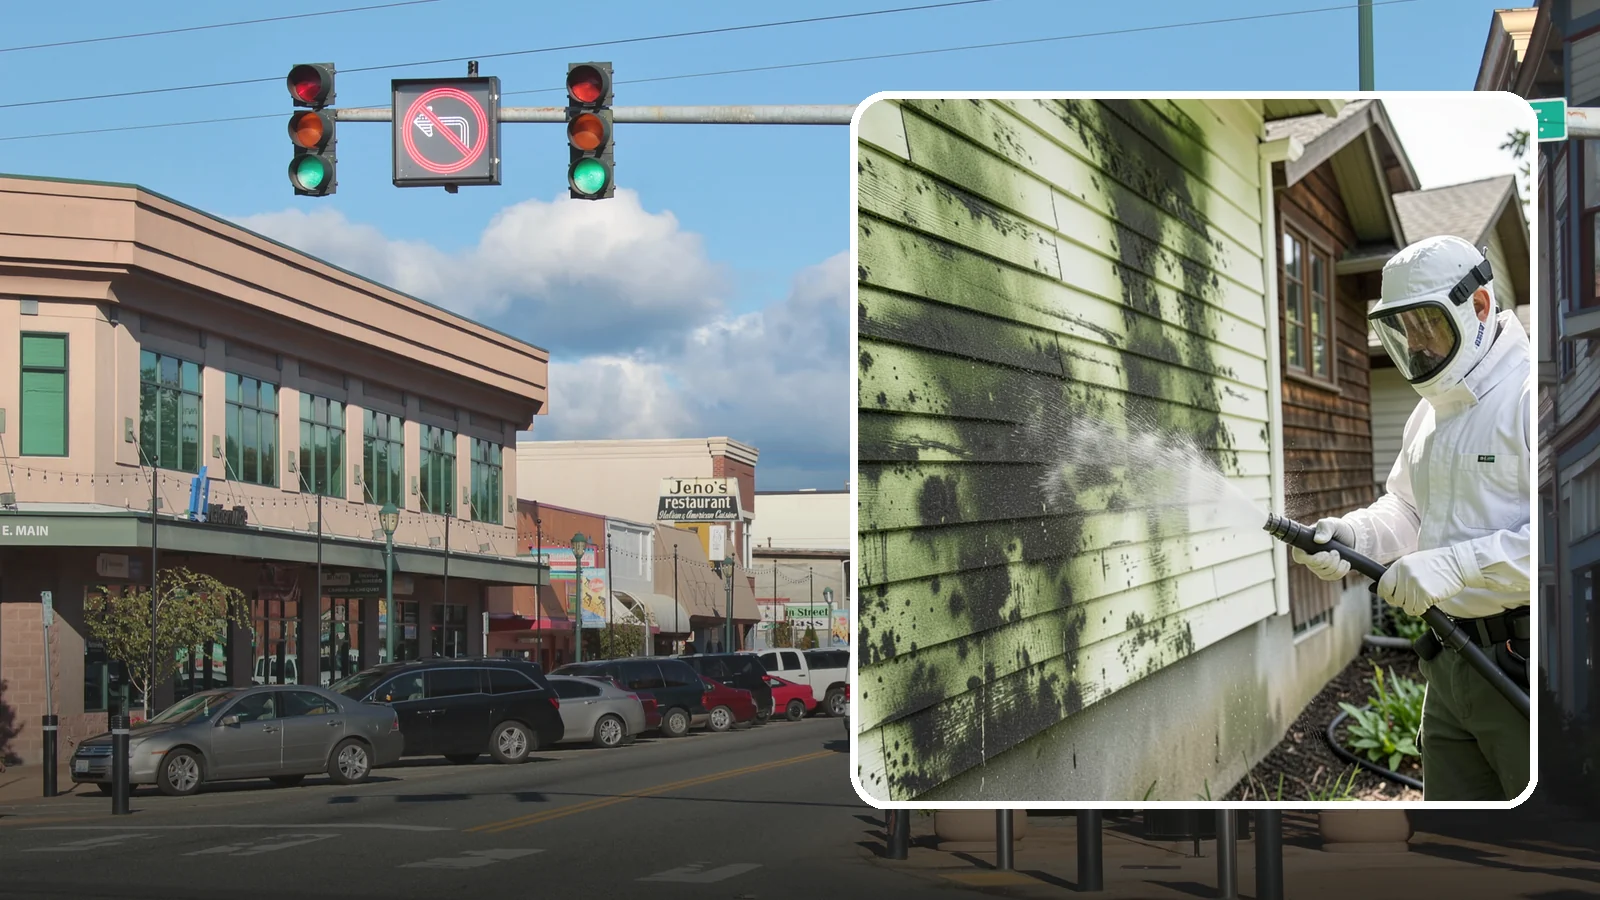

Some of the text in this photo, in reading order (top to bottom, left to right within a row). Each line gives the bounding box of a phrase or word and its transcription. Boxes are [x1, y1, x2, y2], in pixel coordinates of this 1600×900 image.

[669, 480, 728, 495] Jeno's
[665, 497, 731, 509] restaurant
[686, 509, 714, 519] American
[715, 509, 738, 519] Cuisine
[2, 525, 49, 536] E. MAIN
[797, 607, 829, 617] Street
[790, 619, 823, 627] lass
